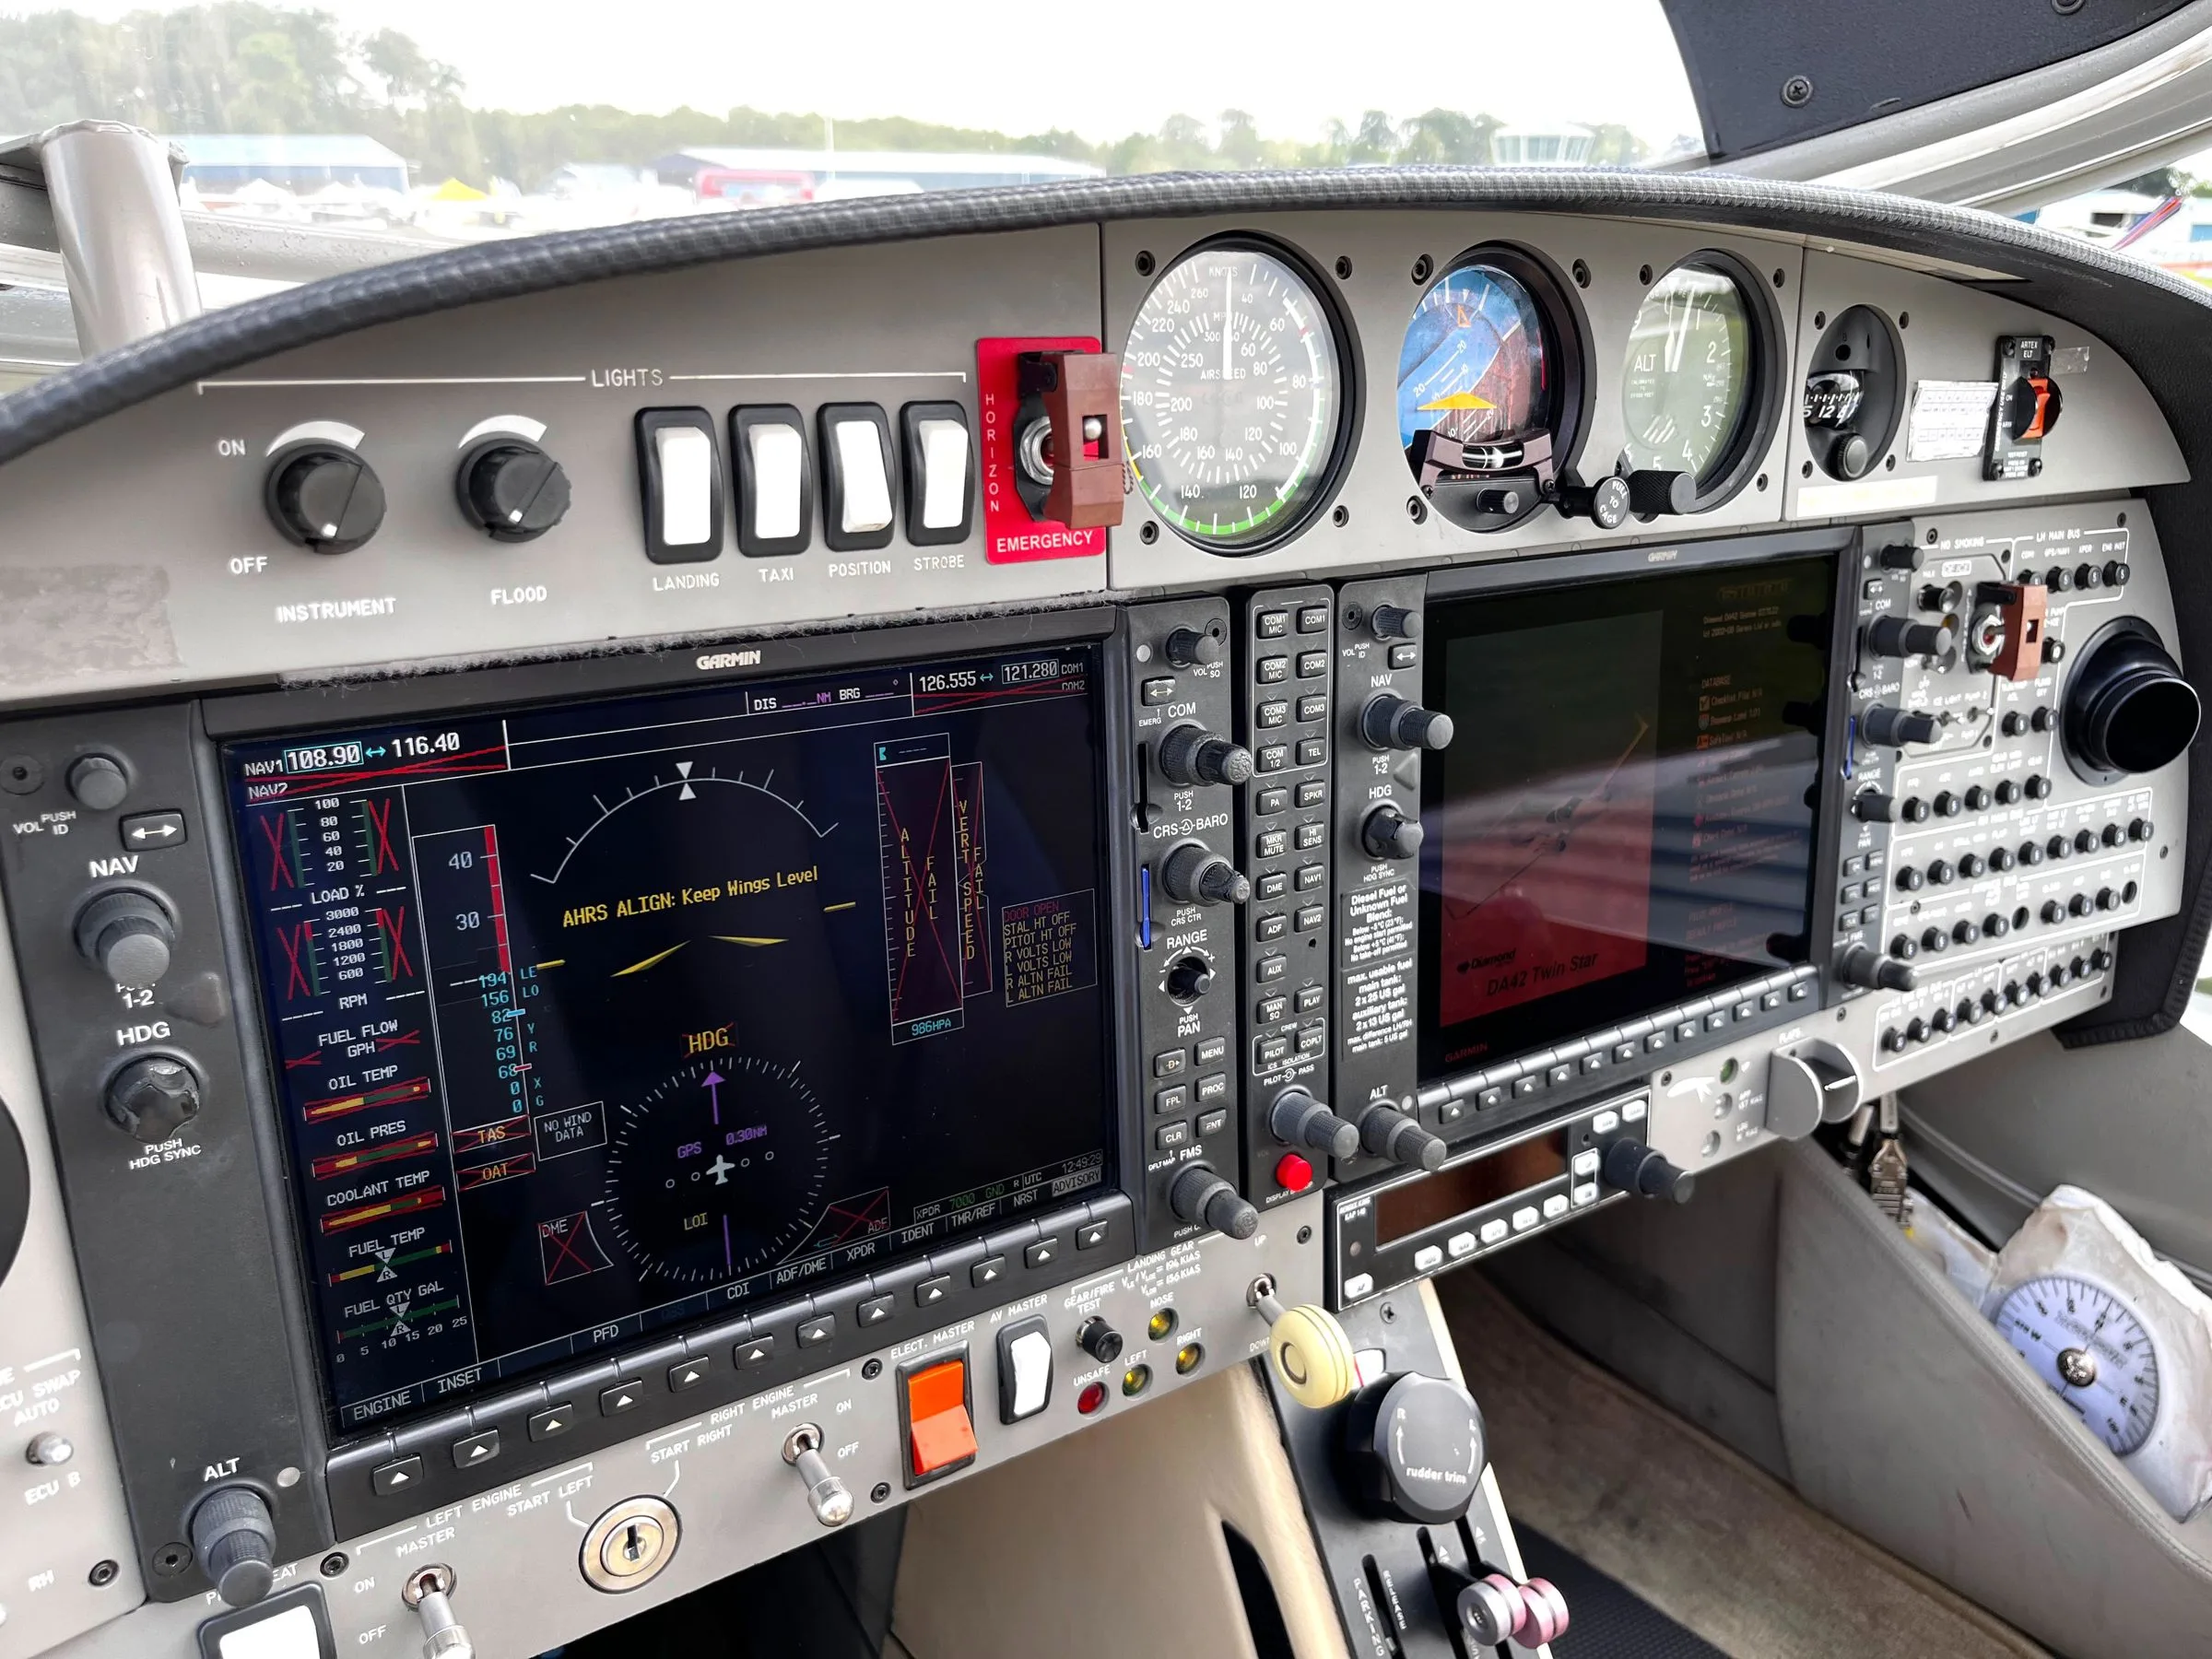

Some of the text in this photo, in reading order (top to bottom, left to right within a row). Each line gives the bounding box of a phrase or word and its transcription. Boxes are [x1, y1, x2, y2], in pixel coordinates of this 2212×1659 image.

[1168, 301, 1190, 314] 240
[1152, 320, 1174, 333] 220
[1270, 320, 1285, 332] 60
[1137, 353, 1160, 366] 200
[1633, 354, 1656, 372] ALT
[1708, 345, 1716, 363] 2
[592, 369, 663, 388] LIGHTS
[1200, 369, 1245, 380] AIRSEED
[1292, 375, 1306, 387] 80
[1133, 393, 1152, 406] 180
[1701, 406, 1712, 426] 3
[218, 440, 245, 456] ON
[985, 394, 1000, 512] HORIZON
[1142, 446, 1161, 458] 160
[1279, 444, 1297, 455] 100
[1181, 486, 1200, 498] 140
[1240, 487, 1257, 498] 120
[1612, 481, 1629, 499] PULL
[1609, 496, 1619, 508] TO
[1599, 504, 1617, 524] CAGE
[996, 530, 1093, 553] EMERGENCY
[229, 557, 267, 574] OFF
[830, 559, 891, 577] POSITION
[913, 555, 965, 571] STROBE
[653, 571, 720, 592] LANDING
[759, 568, 794, 582] TAXI
[491, 585, 547, 605] FLOOD
[276, 597, 396, 622] INSTRUMENT
[1265, 617, 1286, 625] COM1
[1305, 616, 1325, 624] COM1
[697, 650, 761, 670] GARMIN
[919, 661, 1084, 692] 126.555 121.280 COM1
[1268, 670, 1282, 680] MIC
[1371, 674, 1392, 687] NAV
[1168, 702, 1196, 718] COM
[244, 733, 460, 776] NAV1 108.90 116.40
[1271, 799, 1280, 807] PA
[1304, 791, 1323, 801] SPKR
[41, 811, 76, 822] PUSH
[1196, 813, 1228, 830] BARO
[13, 821, 44, 834] VOL
[53, 824, 69, 835] ID
[1154, 823, 1179, 839] CRS
[90, 855, 138, 877] NAV
[1266, 883, 1282, 893] DME
[1304, 874, 1322, 884] NAV1
[311, 885, 365, 904] LOAD %
[562, 865, 818, 927] AHRS ALIGN: Keep Wings Level
[900, 828, 916, 957] ALTITUDE
[1351, 885, 1406, 905] Diesel Fuel or
[1350, 893, 1408, 916] Unknown Fuel
[1004, 912, 1069, 935] STAL HT OFF
[1367, 908, 1392, 923] Blend:
[1167, 929, 1207, 949] RANGE
[1487, 953, 1598, 996] DA42 Twin Star
[123, 990, 154, 1008] 1-2
[339, 994, 368, 1009] RPM
[117, 1022, 171, 1046] HDG
[318, 1019, 398, 1046] FUEL FLOW
[912, 1018, 951, 1037] 986HPA
[1178, 1021, 1200, 1037] PAN
[347, 1041, 375, 1057] GPH
[1201, 1044, 1224, 1059] MENU
[328, 1065, 398, 1090] OIL TEMP
[1202, 1081, 1224, 1095] PROC
[1370, 1086, 1387, 1100] ALT
[1166, 1095, 1181, 1106] FPL
[336, 1120, 406, 1147] OIL PRES
[1165, 1131, 1182, 1143] CLR
[144, 1138, 182, 1154] PUSH
[1180, 1145, 1203, 1160] FMS
[129, 1145, 201, 1170] HDG SYNC
[1024, 1172, 1042, 1185] UTC
[326, 1171, 430, 1206] COOLANT TEMP
[348, 1227, 426, 1258] FUEL TEMP
[1128, 1241, 1194, 1272] LANDING GEAR
[353, 1170, 1100, 1421] ENGINE INSET PFD CDI ADF/DME XPDR IDENT TMR/REF NRST ADVISORY
[1064, 1282, 1115, 1309] GEAR/FIRE
[1150, 1292, 1173, 1309] NOSE
[990, 1294, 1048, 1324] AV MASTER
[1078, 1300, 1102, 1314] TEST
[890, 1321, 975, 1359] ELECT. MASTER
[1176, 1328, 1202, 1346] RIGHT
[1124, 1349, 1147, 1367] LEFT
[1073, 1364, 1111, 1386] UNSAFE
[13, 1399, 59, 1427] AUTO
[711, 1385, 794, 1424] RIGHT ENGINE
[771, 1393, 818, 1419] MASTER
[836, 1399, 852, 1414] ON
[651, 1423, 732, 1465] START RIGHT
[837, 1441, 859, 1459] OFF
[204, 1457, 241, 1481] ALT
[1406, 1466, 1466, 1484] rudder trim
[25, 1472, 81, 1505] ECU B
[507, 1475, 594, 1517] START LEFT
[426, 1484, 522, 1528] LEFT ENGINE
[395, 1527, 455, 1558] MASTER
[354, 1576, 375, 1594] ON
[359, 1625, 387, 1644] OFF
